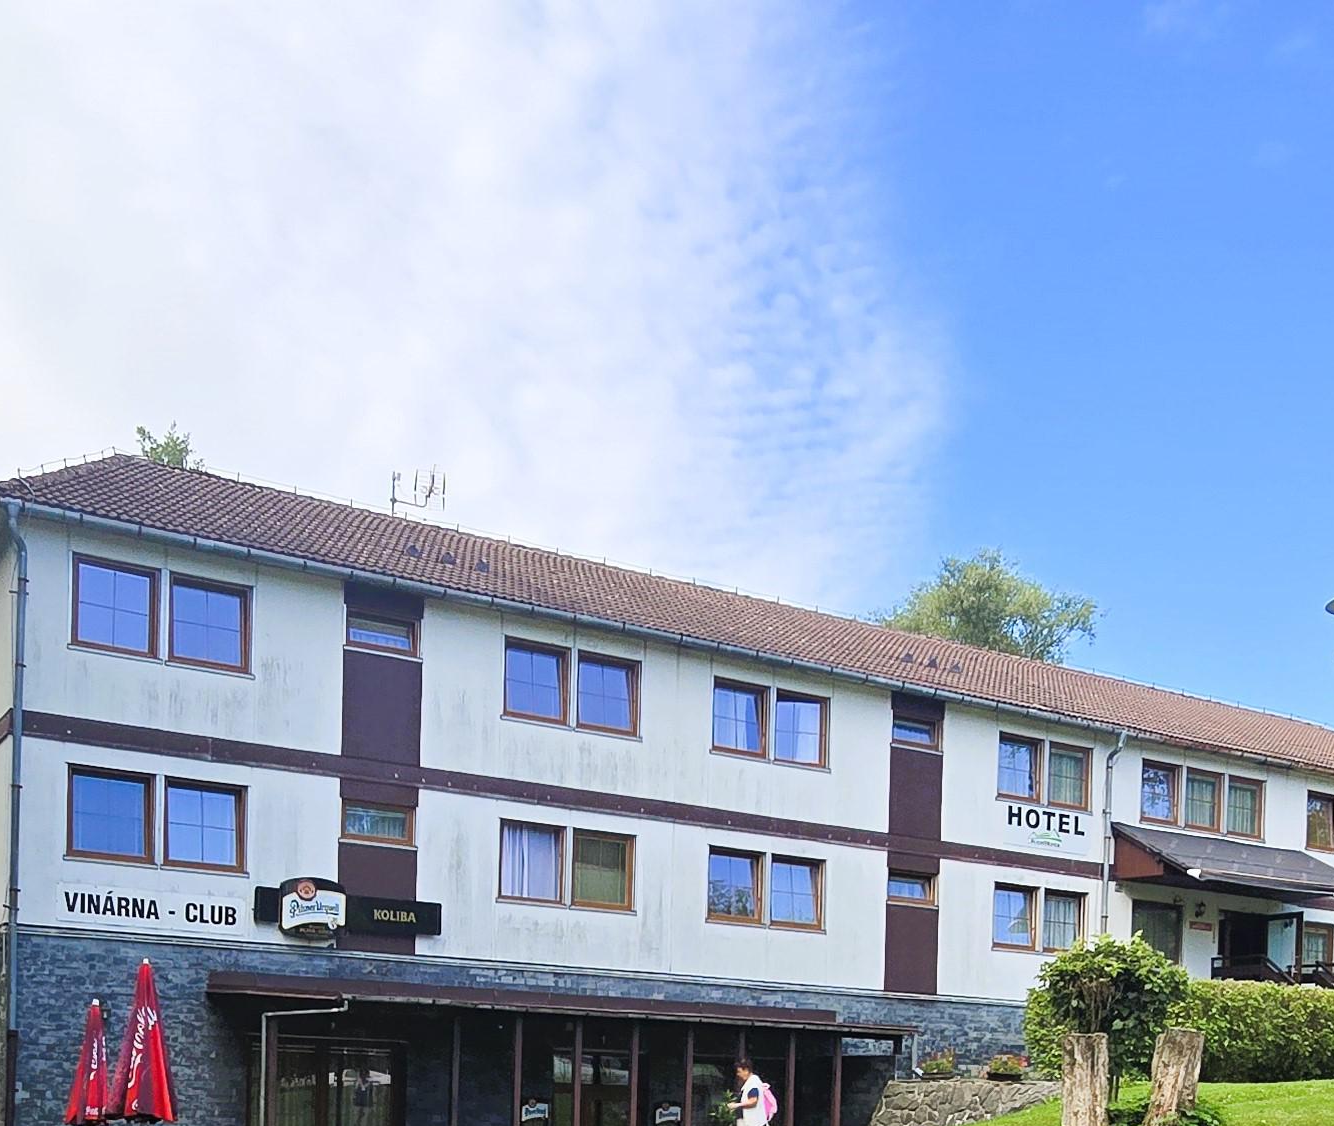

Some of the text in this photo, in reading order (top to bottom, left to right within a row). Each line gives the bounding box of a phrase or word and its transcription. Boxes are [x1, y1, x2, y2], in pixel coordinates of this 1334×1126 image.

[1008, 805, 1085, 836] HOTEL
[64, 890, 159, 920] VINÁRNA
[185, 902, 237, 926] CLUB
[373, 908, 416, 923] KOLIBA
